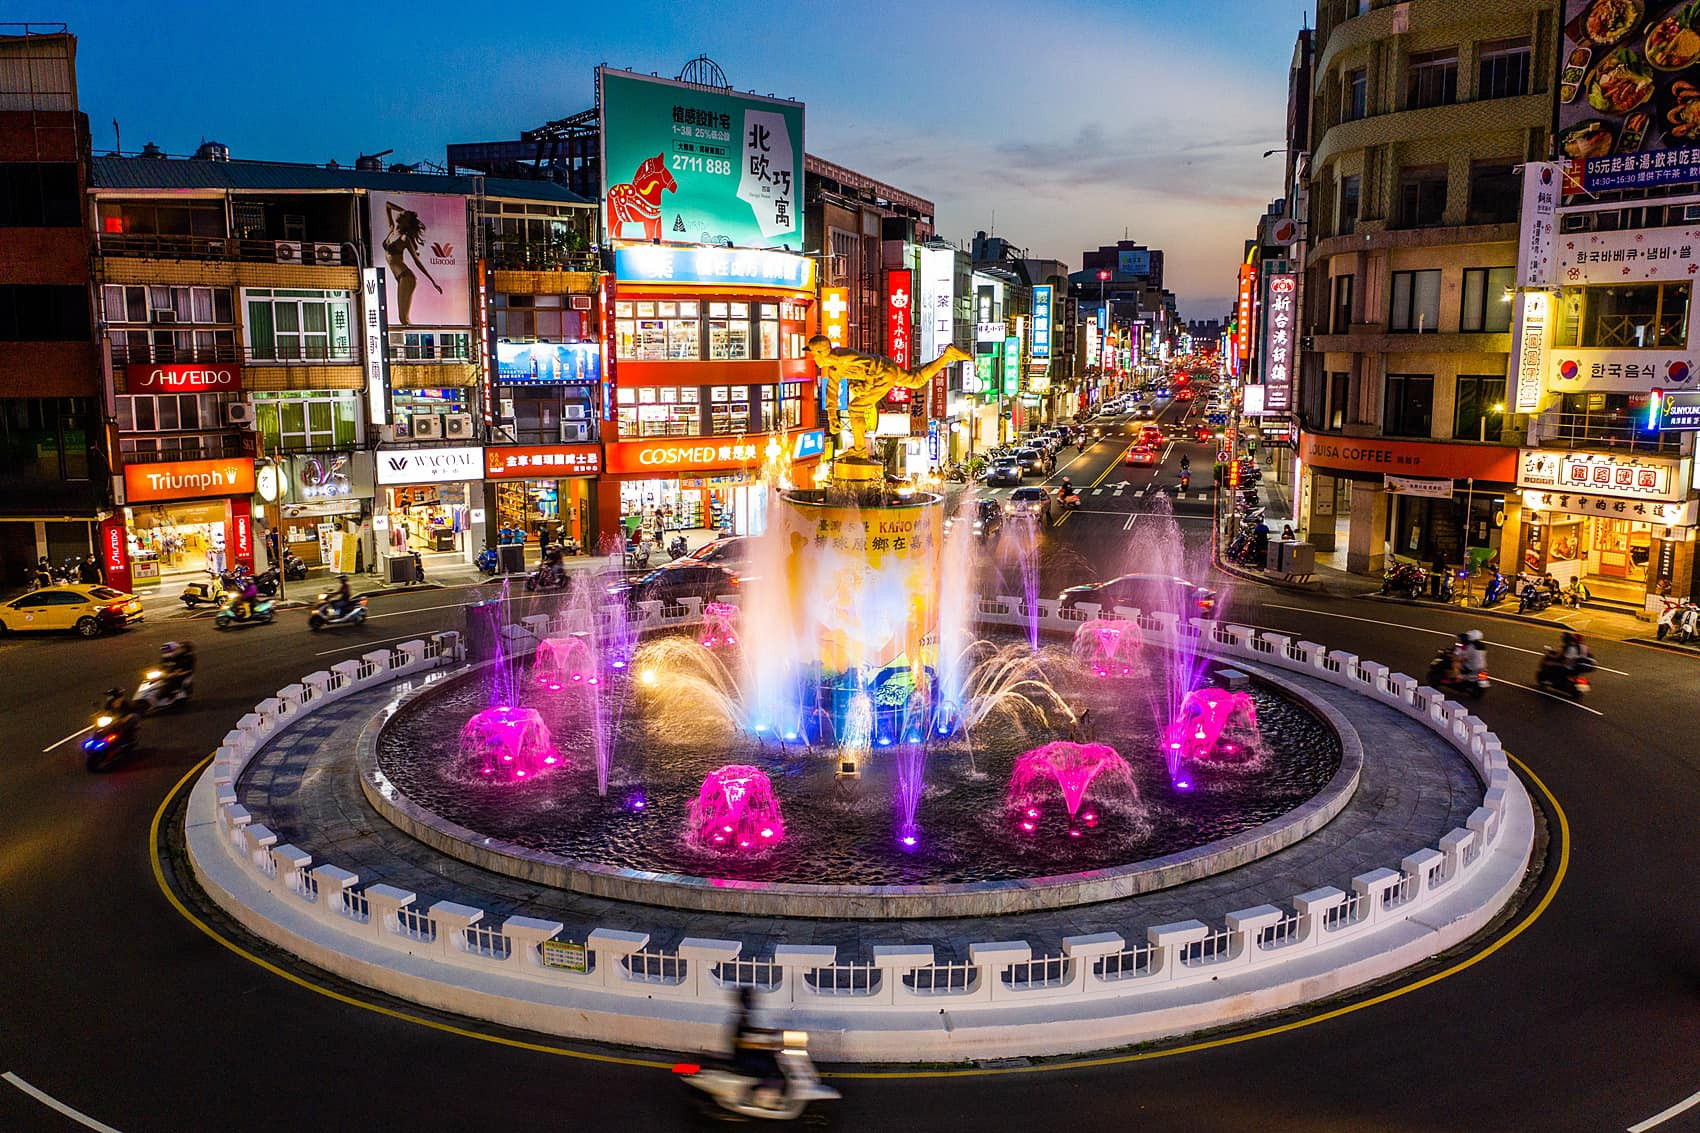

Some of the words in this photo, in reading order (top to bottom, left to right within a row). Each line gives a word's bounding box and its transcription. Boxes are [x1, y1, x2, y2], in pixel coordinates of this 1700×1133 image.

[672, 104, 730, 130] 植感設計宅
[672, 154, 703, 173] 2711
[706, 158, 731, 176] 888
[140, 369, 231, 386] SHISEIDO
[1591, 363, 1656, 379] 한국음식
[414, 452, 475, 467] WACOAL
[639, 446, 716, 465] COSMED
[1309, 444, 1339, 459] LOUISA
[1342, 447, 1393, 463] COFFEE
[147, 470, 223, 491] Triumph
[1573, 465, 1656, 487] 鐵路便當
[238, 518, 246, 552] SHISEIDO
[879, 520, 913, 533] KANO
[110, 529, 120, 565] SHISEIDO
